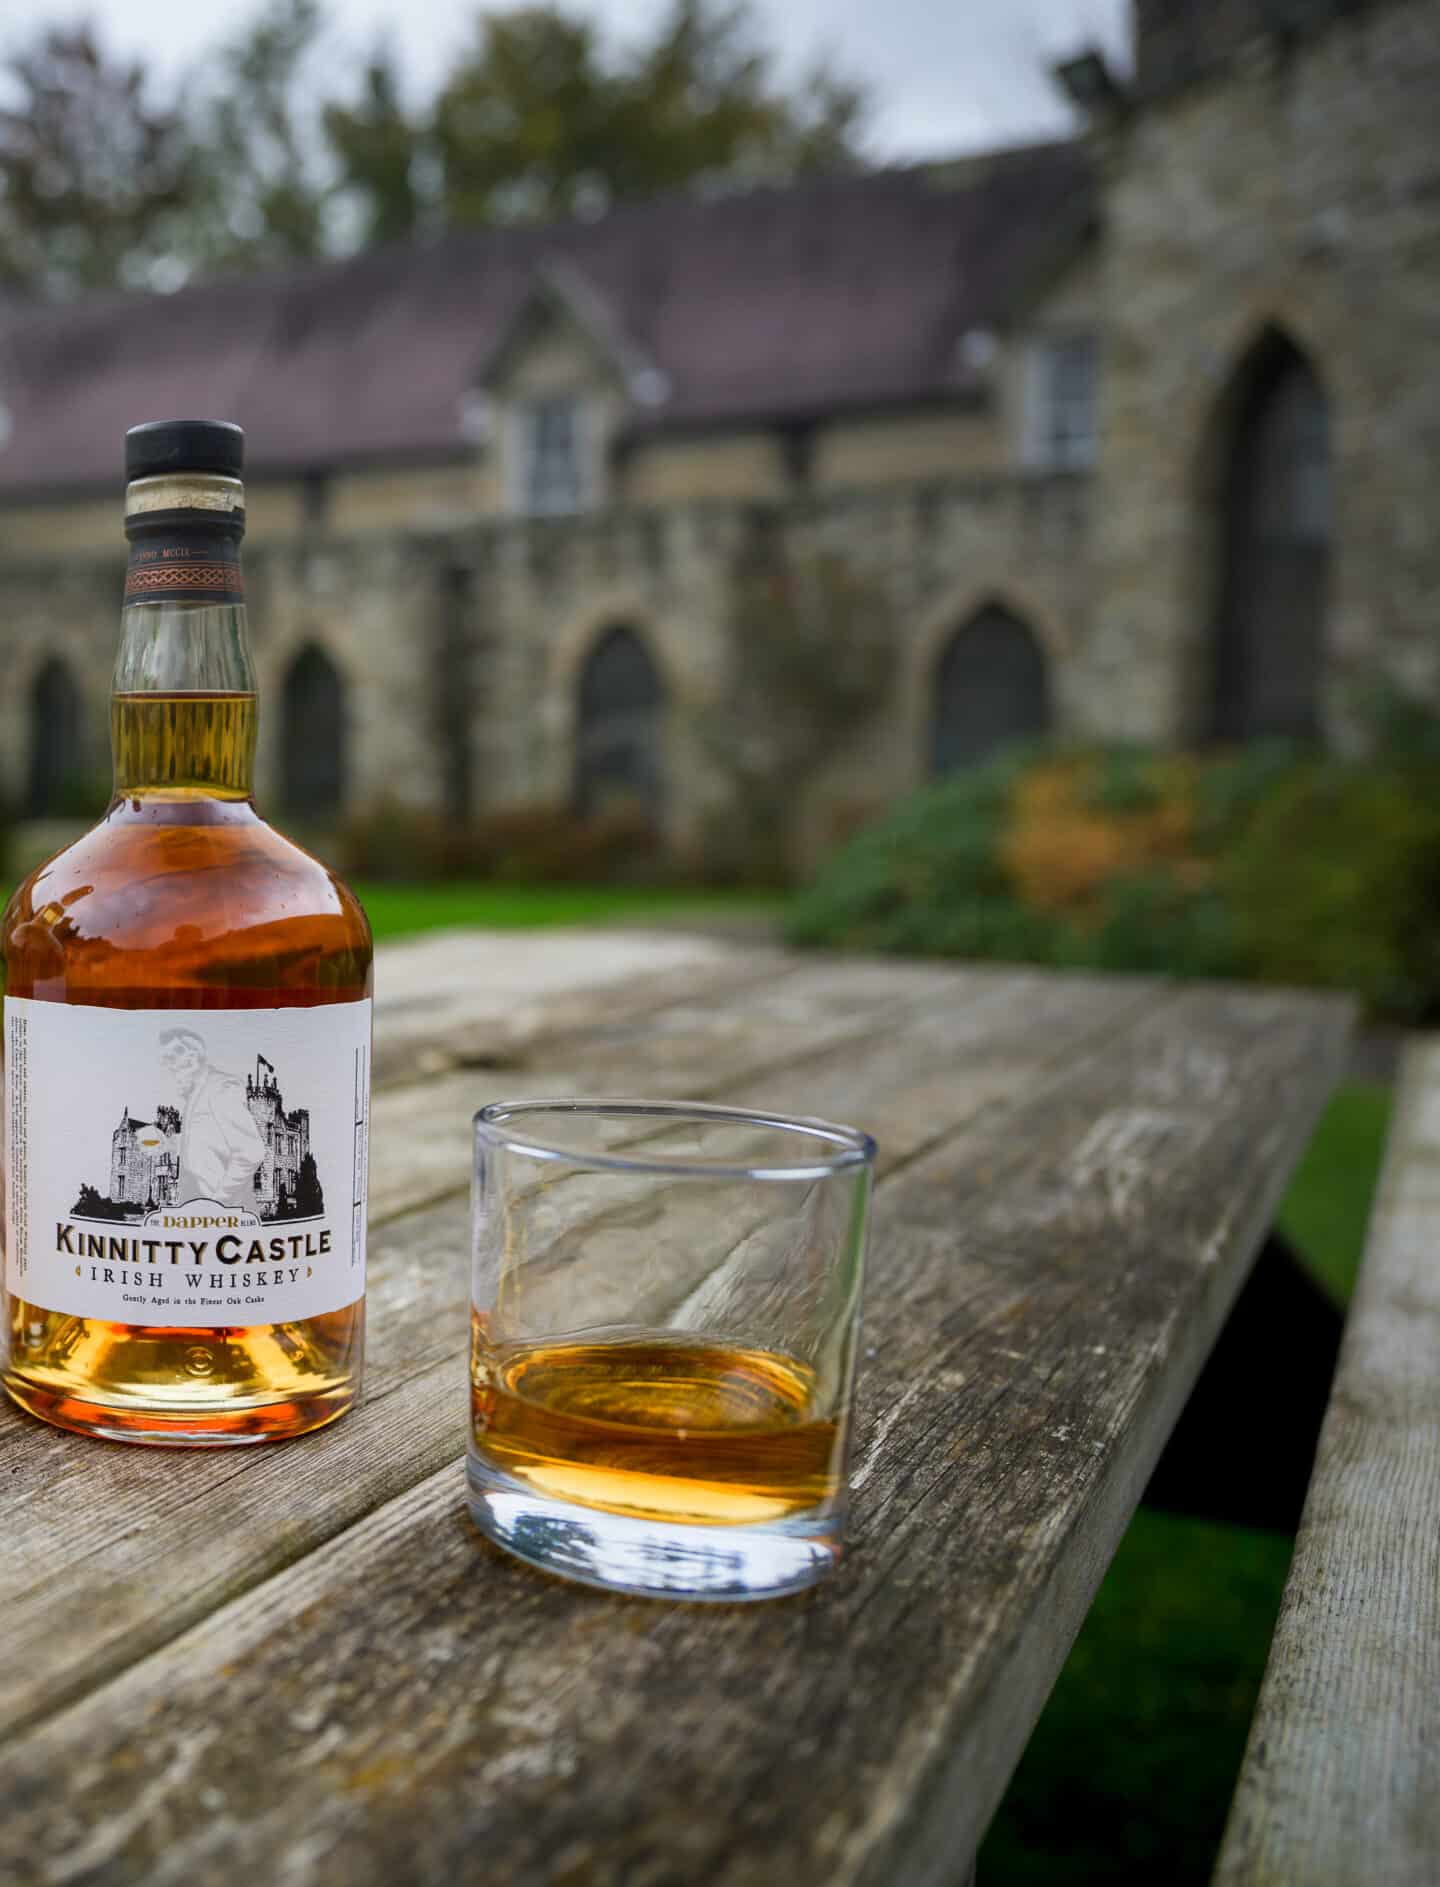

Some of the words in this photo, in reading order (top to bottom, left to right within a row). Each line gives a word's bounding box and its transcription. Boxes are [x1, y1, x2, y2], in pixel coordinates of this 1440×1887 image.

[55, 1222, 209, 1265] KINNITTY
[215, 1229, 333, 1265] CASTLE
[90, 1266, 164, 1288] IRISH
[184, 1267, 301, 1289] WHISKEY
[151, 1296, 171, 1306] Aged
[173, 1296, 182, 1305] in
[184, 1296, 197, 1305] the
[226, 1296, 242, 1305] Oak
[244, 1294, 265, 1304] Casks
